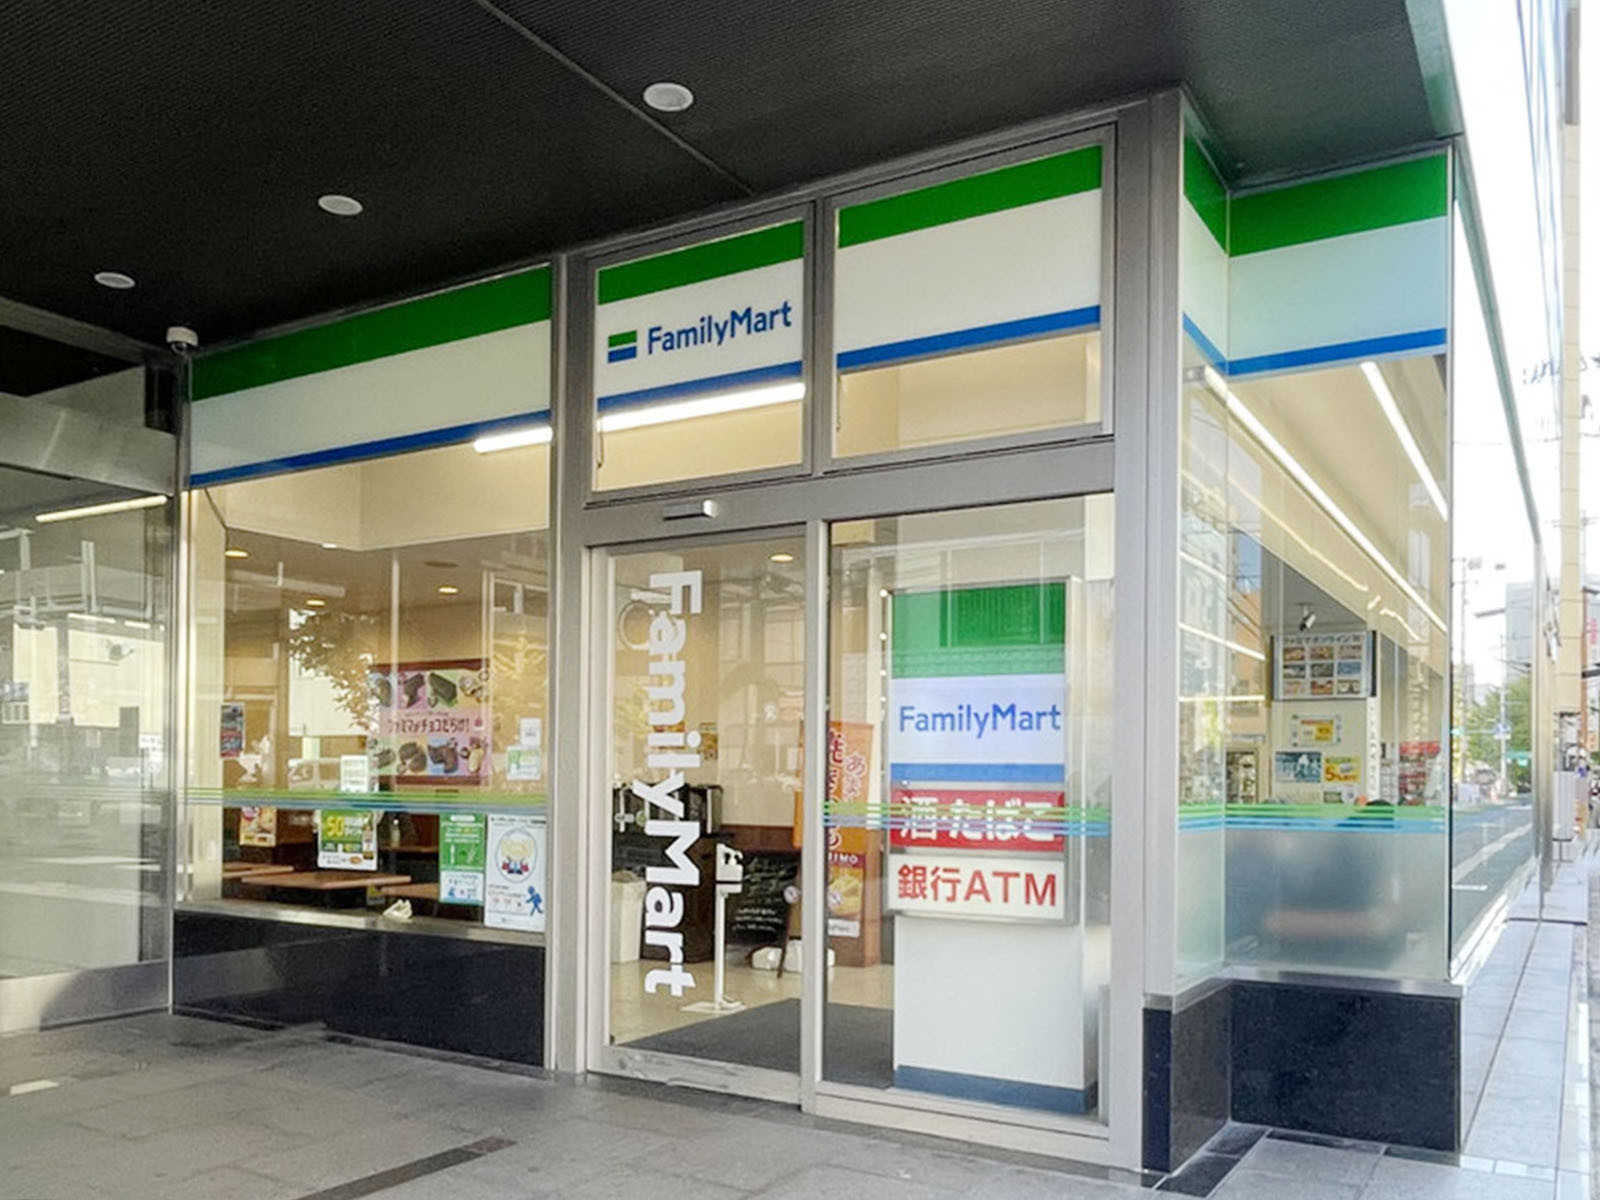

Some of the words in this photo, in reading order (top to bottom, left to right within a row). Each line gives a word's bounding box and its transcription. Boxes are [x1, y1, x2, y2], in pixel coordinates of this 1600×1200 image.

[647, 301, 793, 355] FamilyMart
[899, 703, 1062, 739] FamilyMart
[632, 569, 702, 998] FamilyMart
[897, 863, 1057, 907] 銀行ATM
